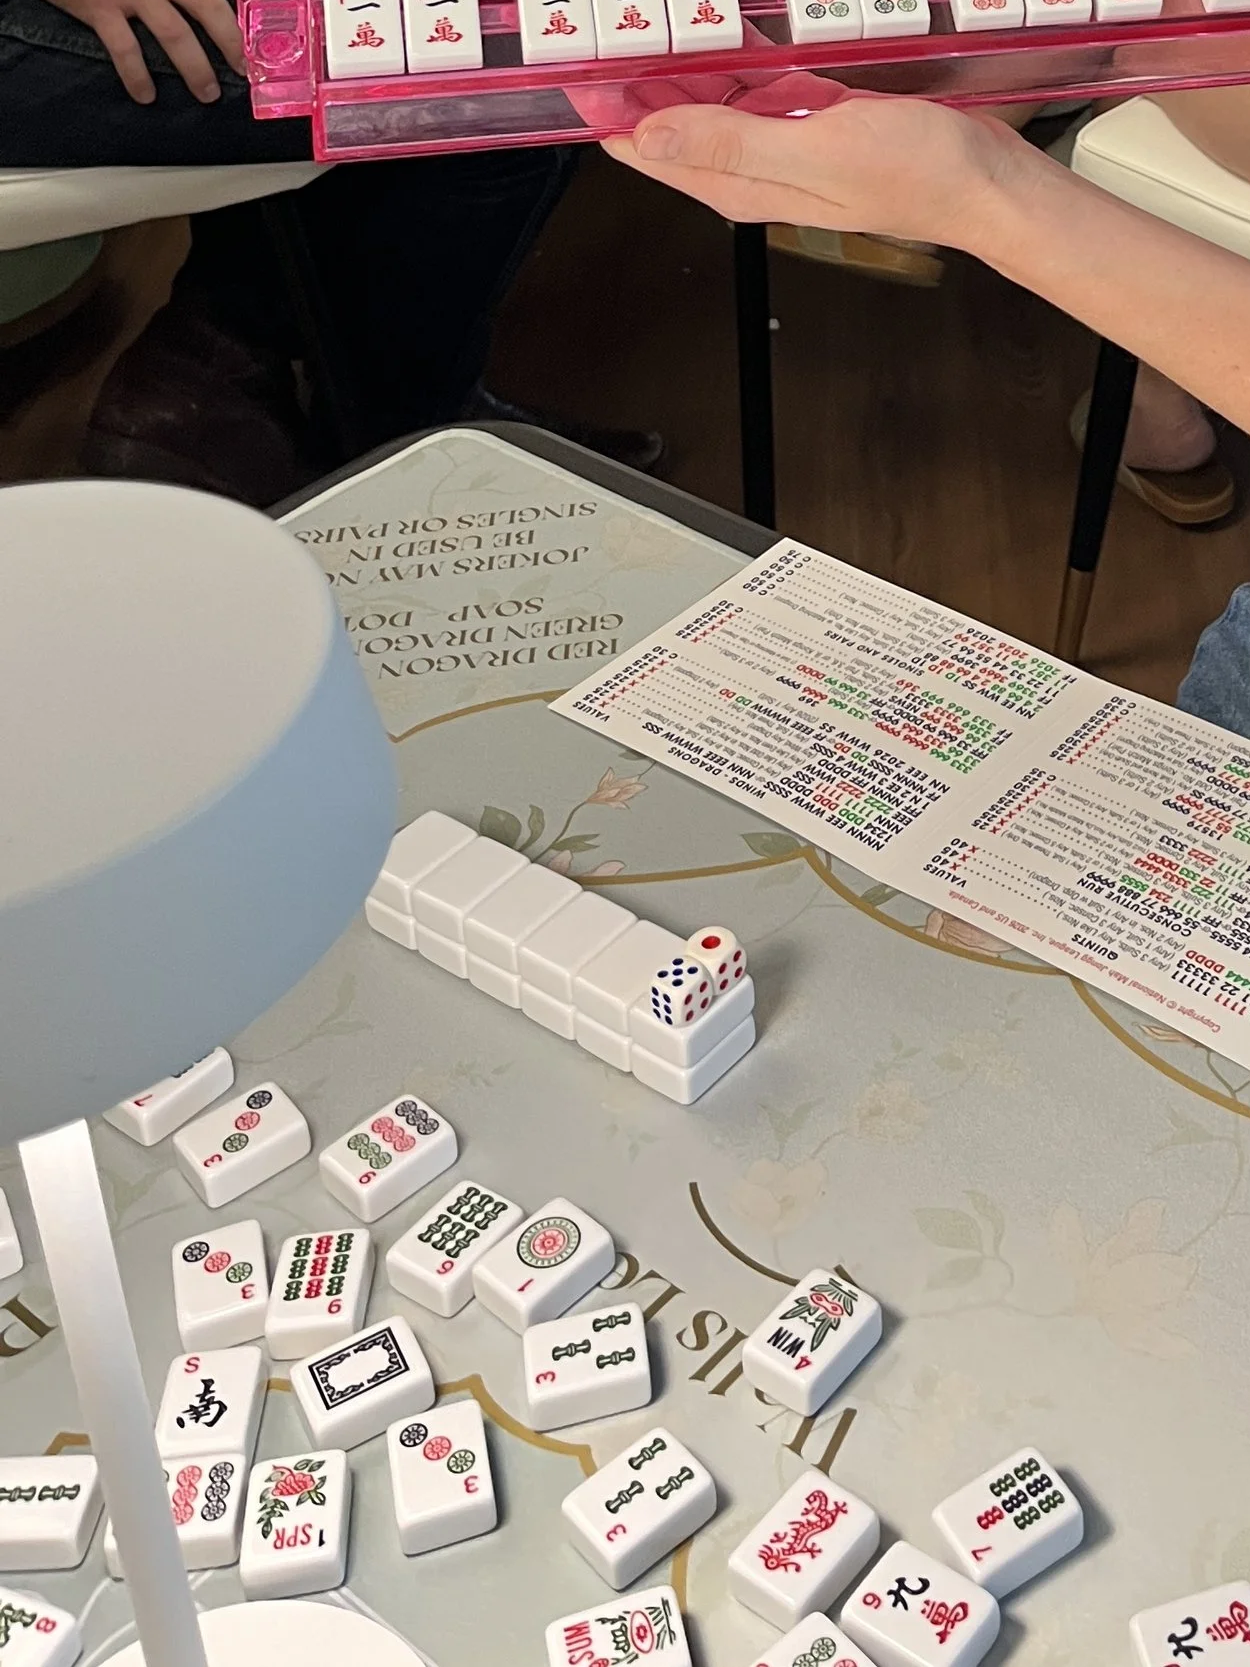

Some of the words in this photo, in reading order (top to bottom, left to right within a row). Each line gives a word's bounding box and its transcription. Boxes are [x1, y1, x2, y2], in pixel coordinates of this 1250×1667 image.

[398, 518, 448, 535] OR
[458, 501, 598, 531] SINGLES
[393, 535, 484, 559] USED
[494, 529, 536, 548] BE
[345, 542, 387, 564] IN
[453, 546, 589, 575] JOKERS
[368, 567, 441, 584] MAY
[449, 597, 544, 623] SOAP
[508, 612, 624, 640] GREEN
[822, 629, 857, 647] PAIRS
[548, 638, 619, 662] RED
[855, 643, 881, 657] AND
[378, 645, 536, 679] DRAGON
[879, 653, 925, 677] SINGLES
[571, 700, 611, 722] VALUES
[666, 745, 722, 776] DRAGONS
[727, 776, 768, 799] WINDS
[1185, 818, 1226, 841] 13579
[921, 861, 969, 888] VALUES
[1075, 877, 1105, 895] RUN
[1103, 890, 1193, 938] CONSECUTIVE
[1069, 932, 1120, 961] QUINTS
[135, 1094, 152, 1108] 7
[203, 1154, 223, 1168] 3
[241, 1283, 254, 1300] 3
[517, 1278, 532, 1293] 1
[767, 1326, 805, 1359] WIN
[184, 1356, 200, 1374] S
[795, 1355, 812, 1371] 4
[536, 1370, 556, 1384] 3
[463, 1475, 479, 1494] 3
[272, 1523, 313, 1550] SPR
[317, 1528, 326, 1548] 1
[606, 1523, 628, 1542] 3
[970, 1545, 993, 1562] 7
[35, 1617, 58, 1634] 8
[563, 1620, 596, 1667] SUM
